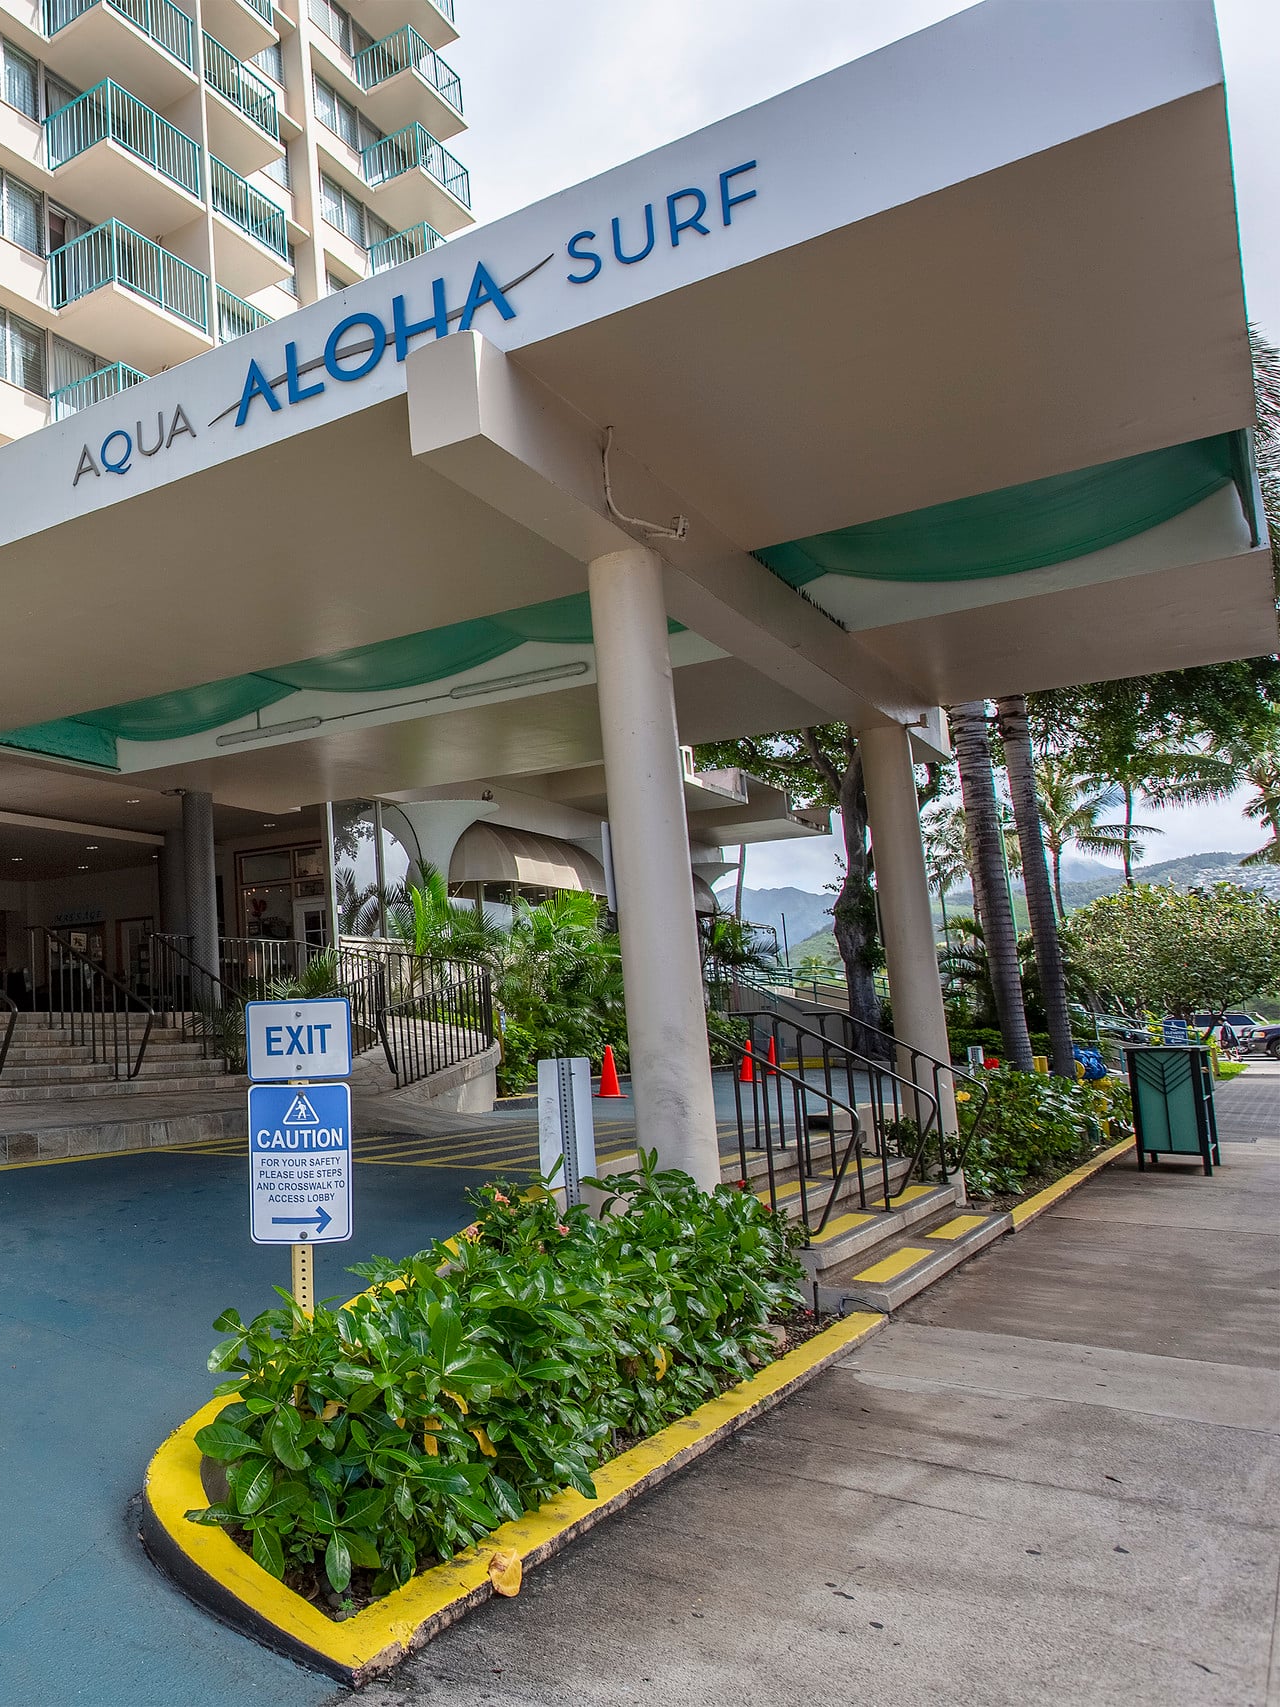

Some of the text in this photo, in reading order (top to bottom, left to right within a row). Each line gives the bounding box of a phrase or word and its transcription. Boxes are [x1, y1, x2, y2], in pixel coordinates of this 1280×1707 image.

[71, 159, 759, 487] AQUA ALOHA SURF
[265, 1023, 332, 1057] EXIT
[256, 1127, 344, 1149] CAUTION
[261, 1156, 341, 1167] FOR YOUR SAFETY
[259, 1168, 343, 1179] PLEASE USE STEPS
[256, 1180, 346, 1191] AND CROSSWALK TO
[268, 1192, 336, 1203] ACCESS LOBBY
